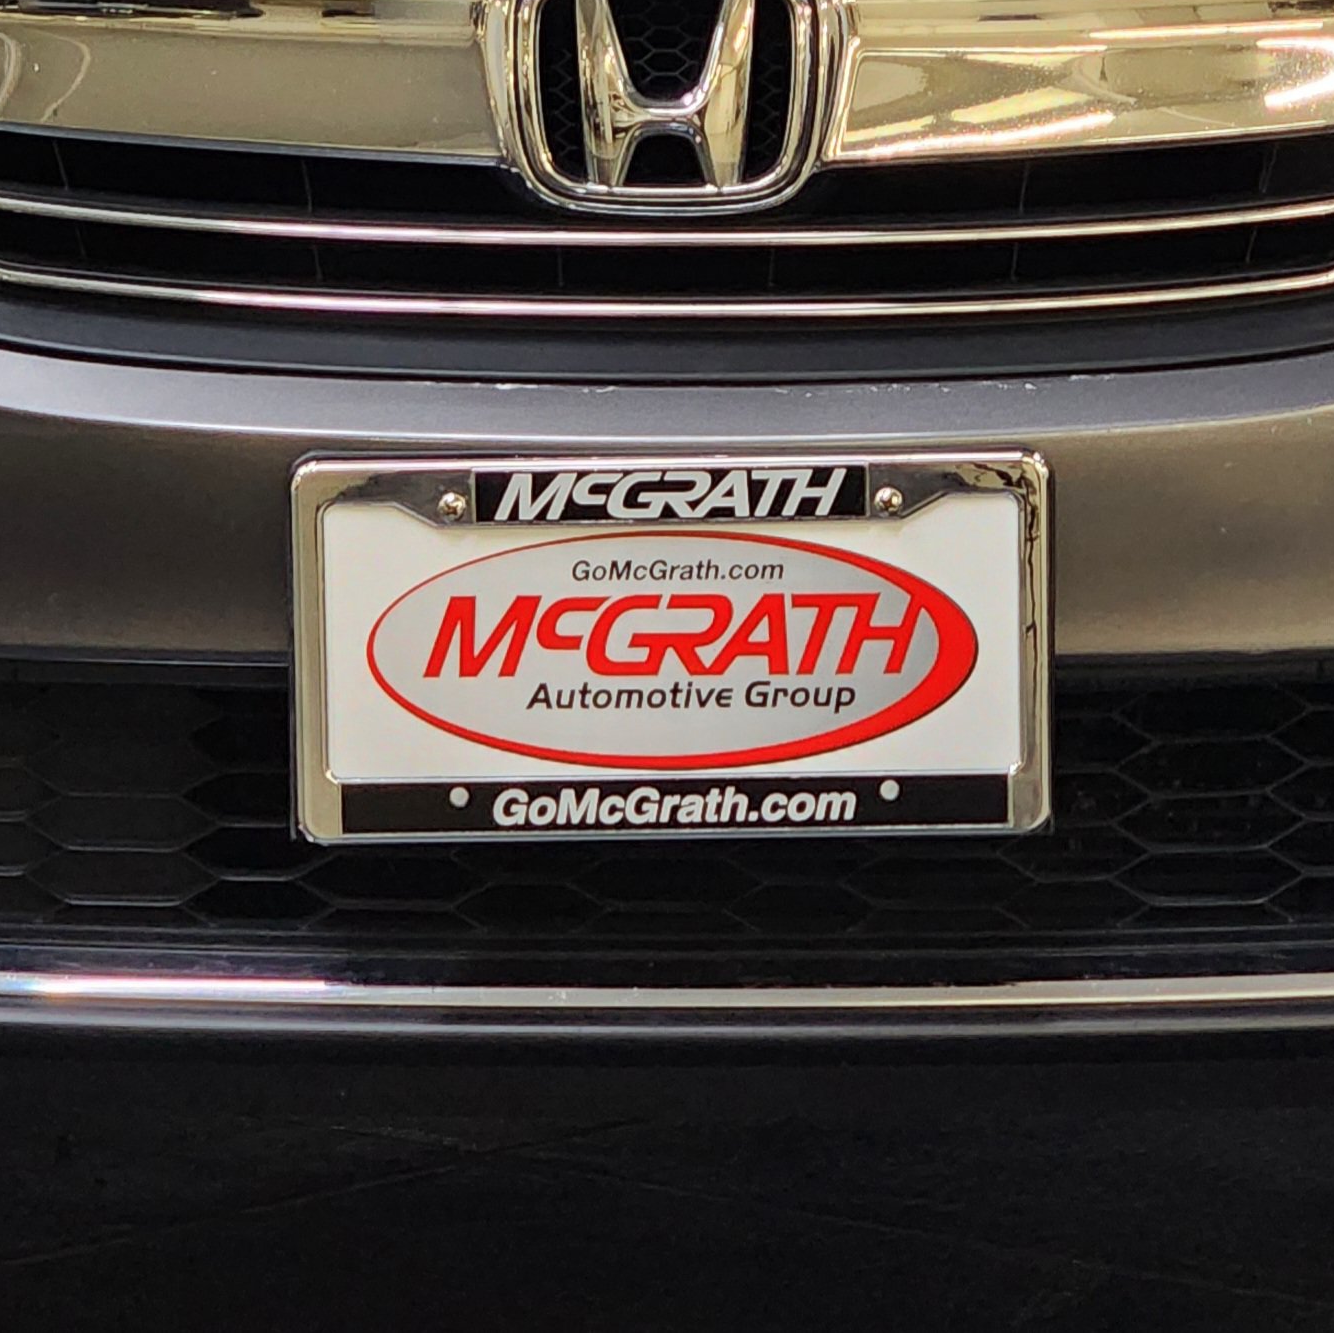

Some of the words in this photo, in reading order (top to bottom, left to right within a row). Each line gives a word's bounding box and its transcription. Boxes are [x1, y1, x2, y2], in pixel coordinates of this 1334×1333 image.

[572, 558, 784, 582] GoMcGrath.com
[526, 680, 733, 710] Automotive
[746, 680, 856, 713] Group
[493, 786, 857, 827] GoMcGrath.com
